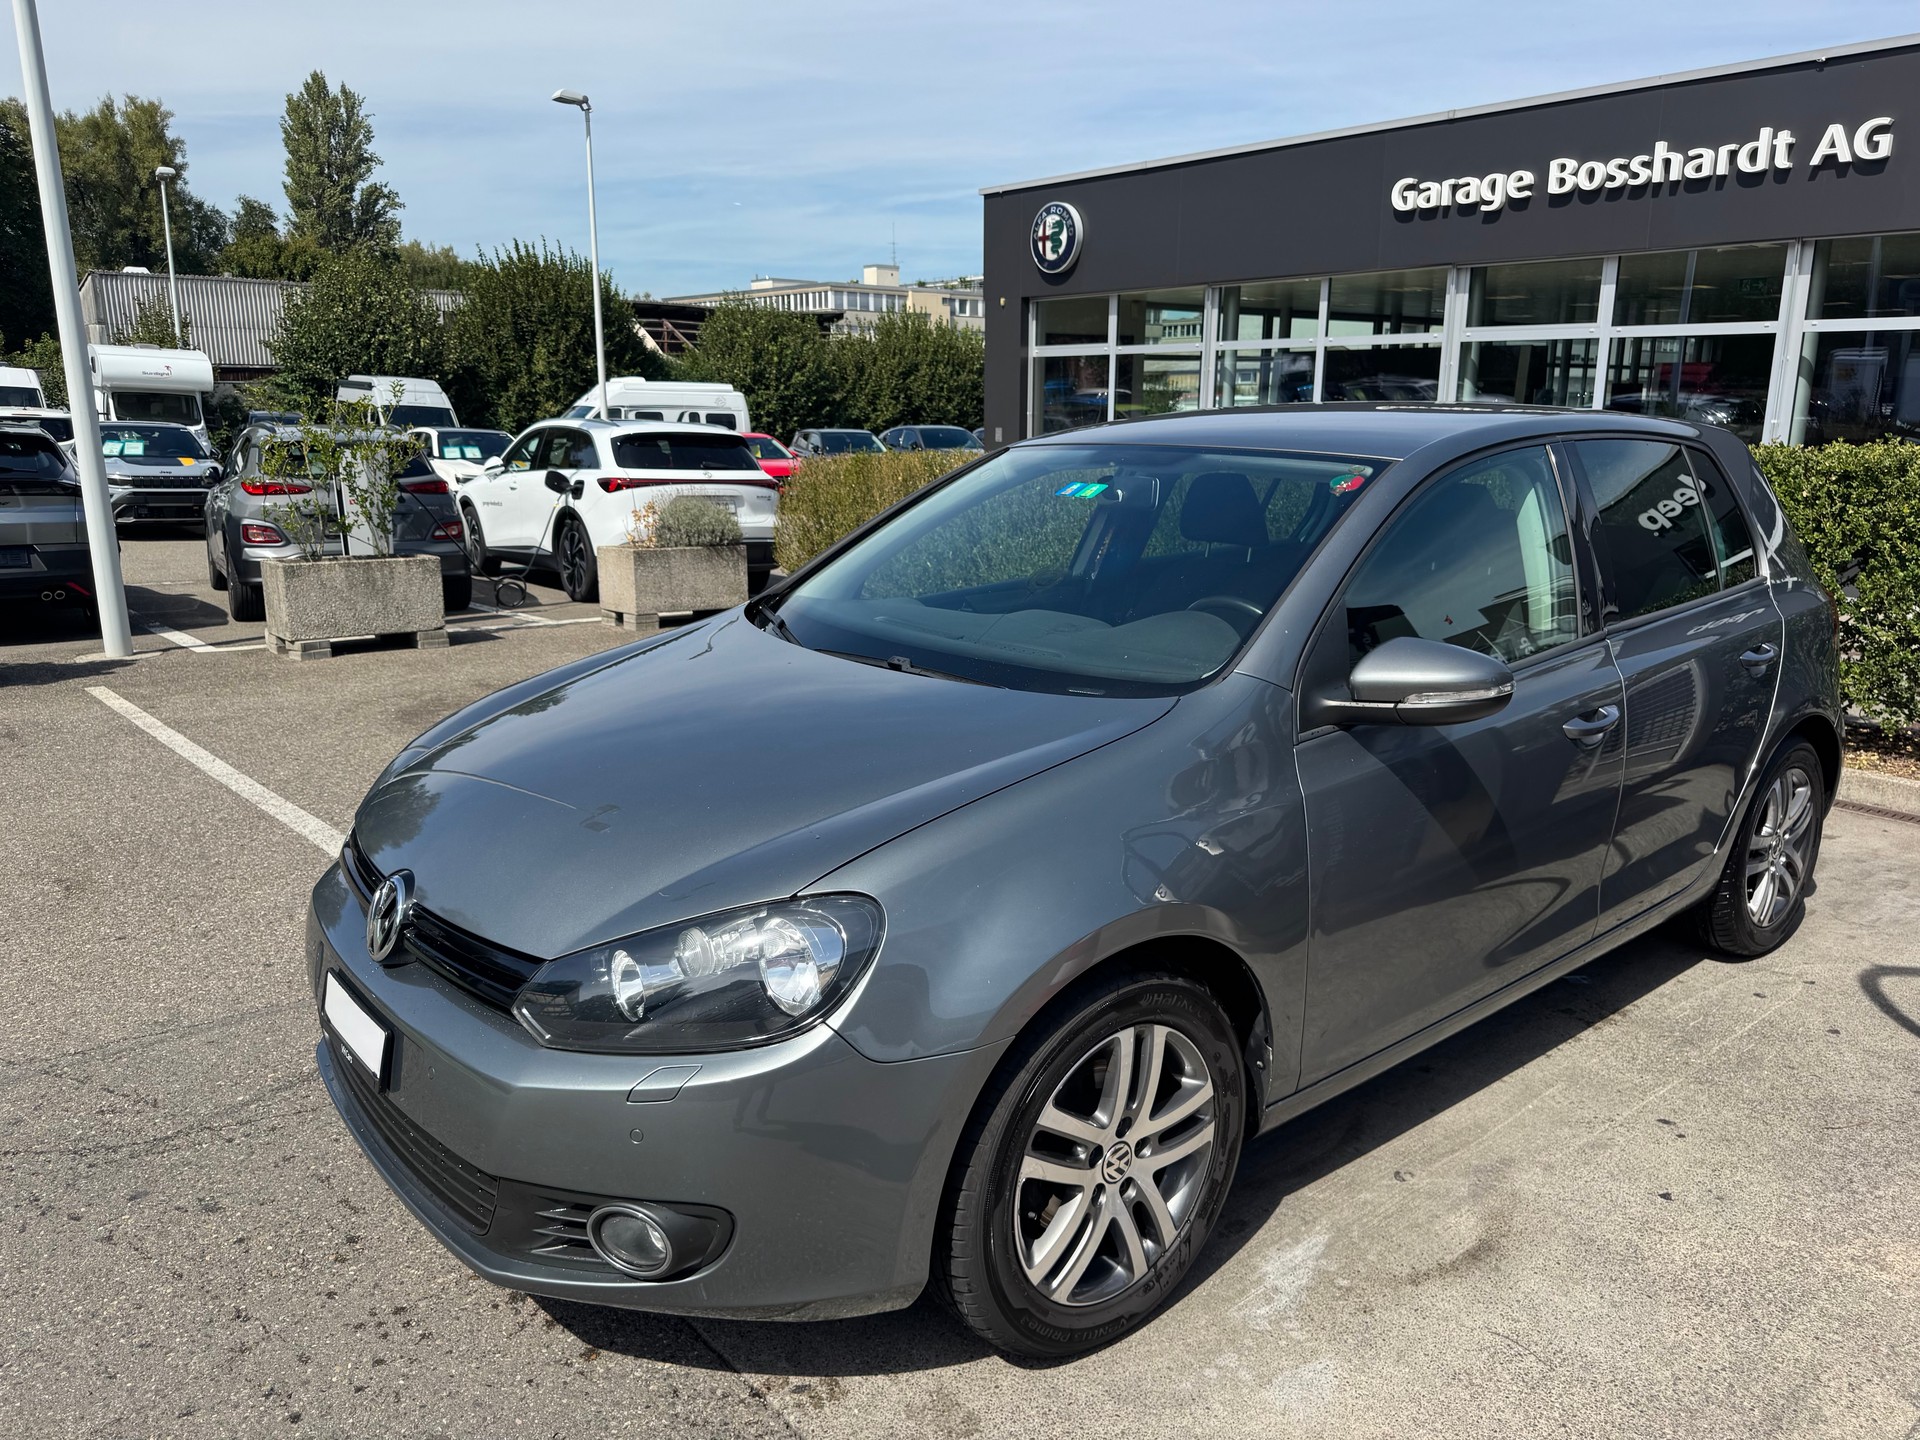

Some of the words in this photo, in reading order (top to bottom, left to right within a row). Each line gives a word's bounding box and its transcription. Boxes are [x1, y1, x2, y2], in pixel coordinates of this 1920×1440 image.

[1391, 170, 1535, 212] Garage
[1547, 126, 1796, 195] Bosshardt
[1809, 117, 1895, 167] AG
[1033, 211, 1048, 240] ALFA
[1050, 206, 1074, 237] ROMEO
